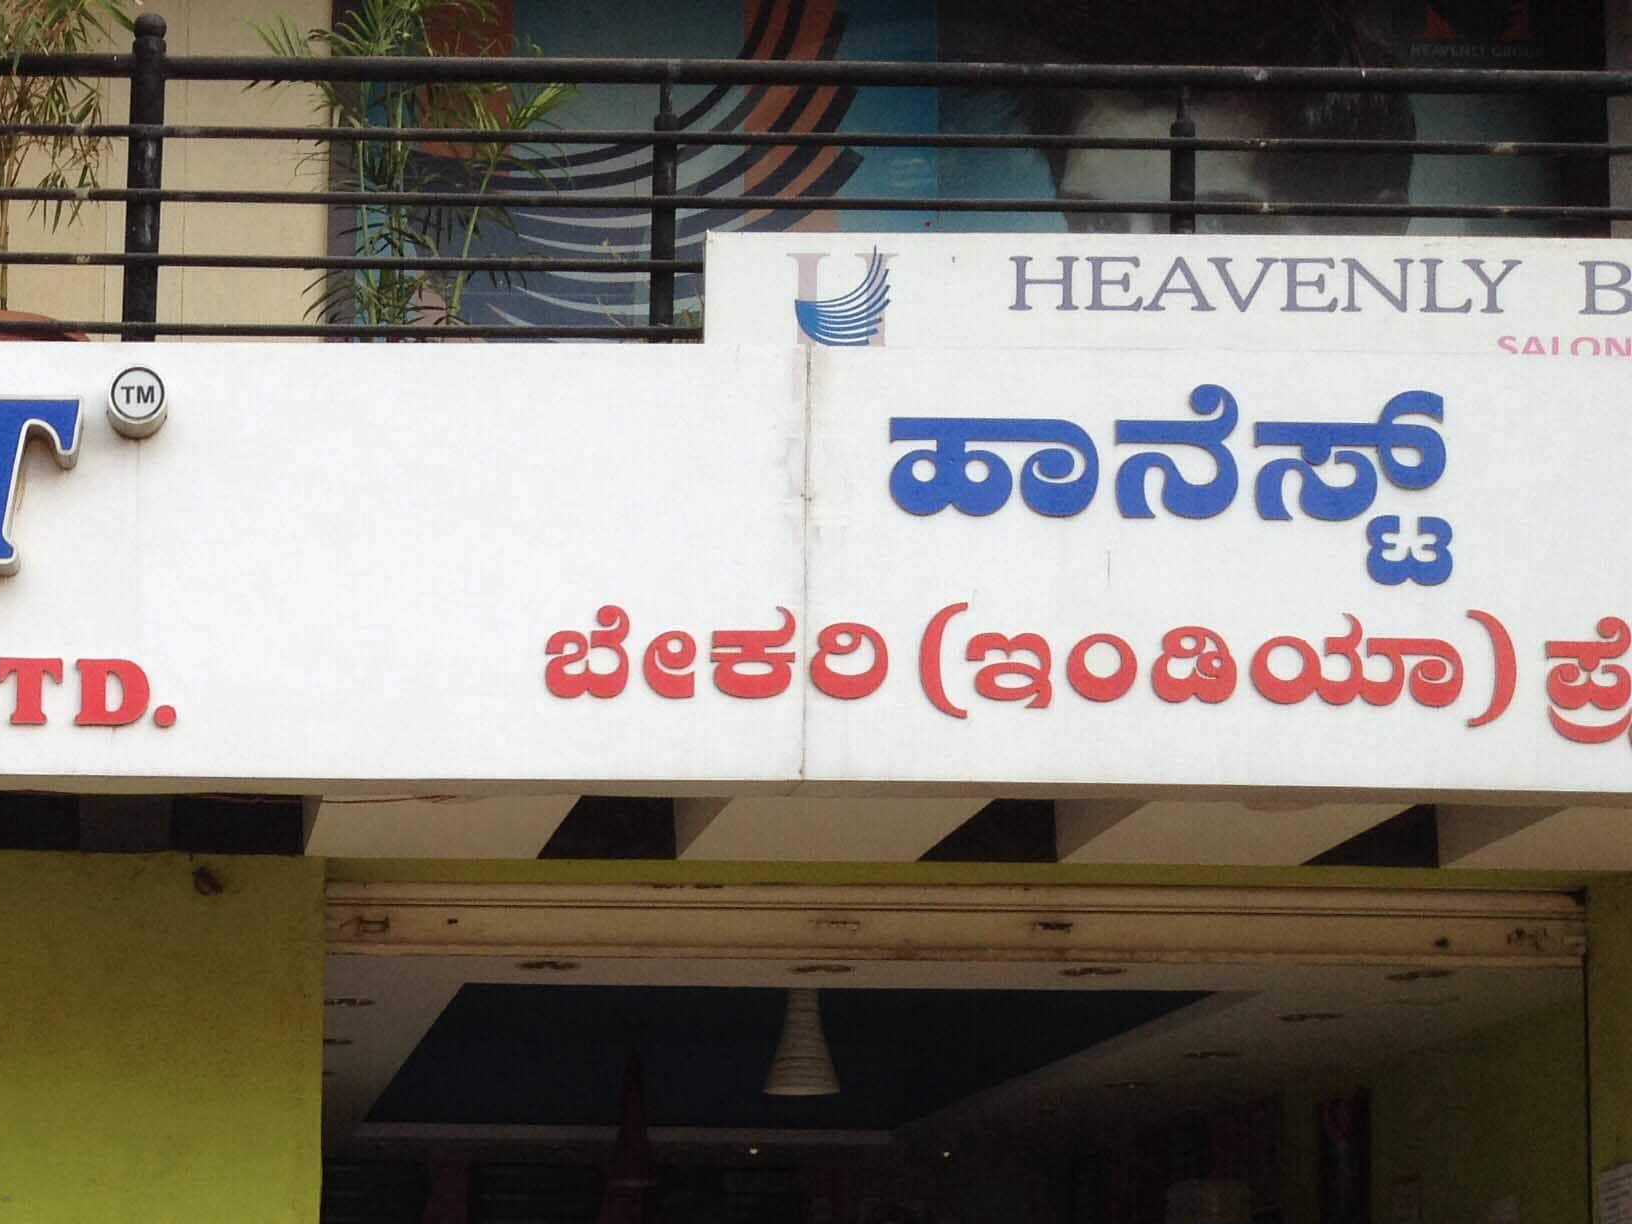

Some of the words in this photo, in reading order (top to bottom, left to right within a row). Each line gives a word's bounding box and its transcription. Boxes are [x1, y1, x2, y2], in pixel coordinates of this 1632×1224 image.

[1007, 254, 1524, 317] HEAVENLY
[120, 384, 156, 405] TM
[888, 384, 1455, 587] ಹಾನೆಸ್ಟ್
[544, 603, 890, 702] ಬೇಕರಿ
[919, 601, 1518, 728] (ಇಂಡಿಯಾ)
